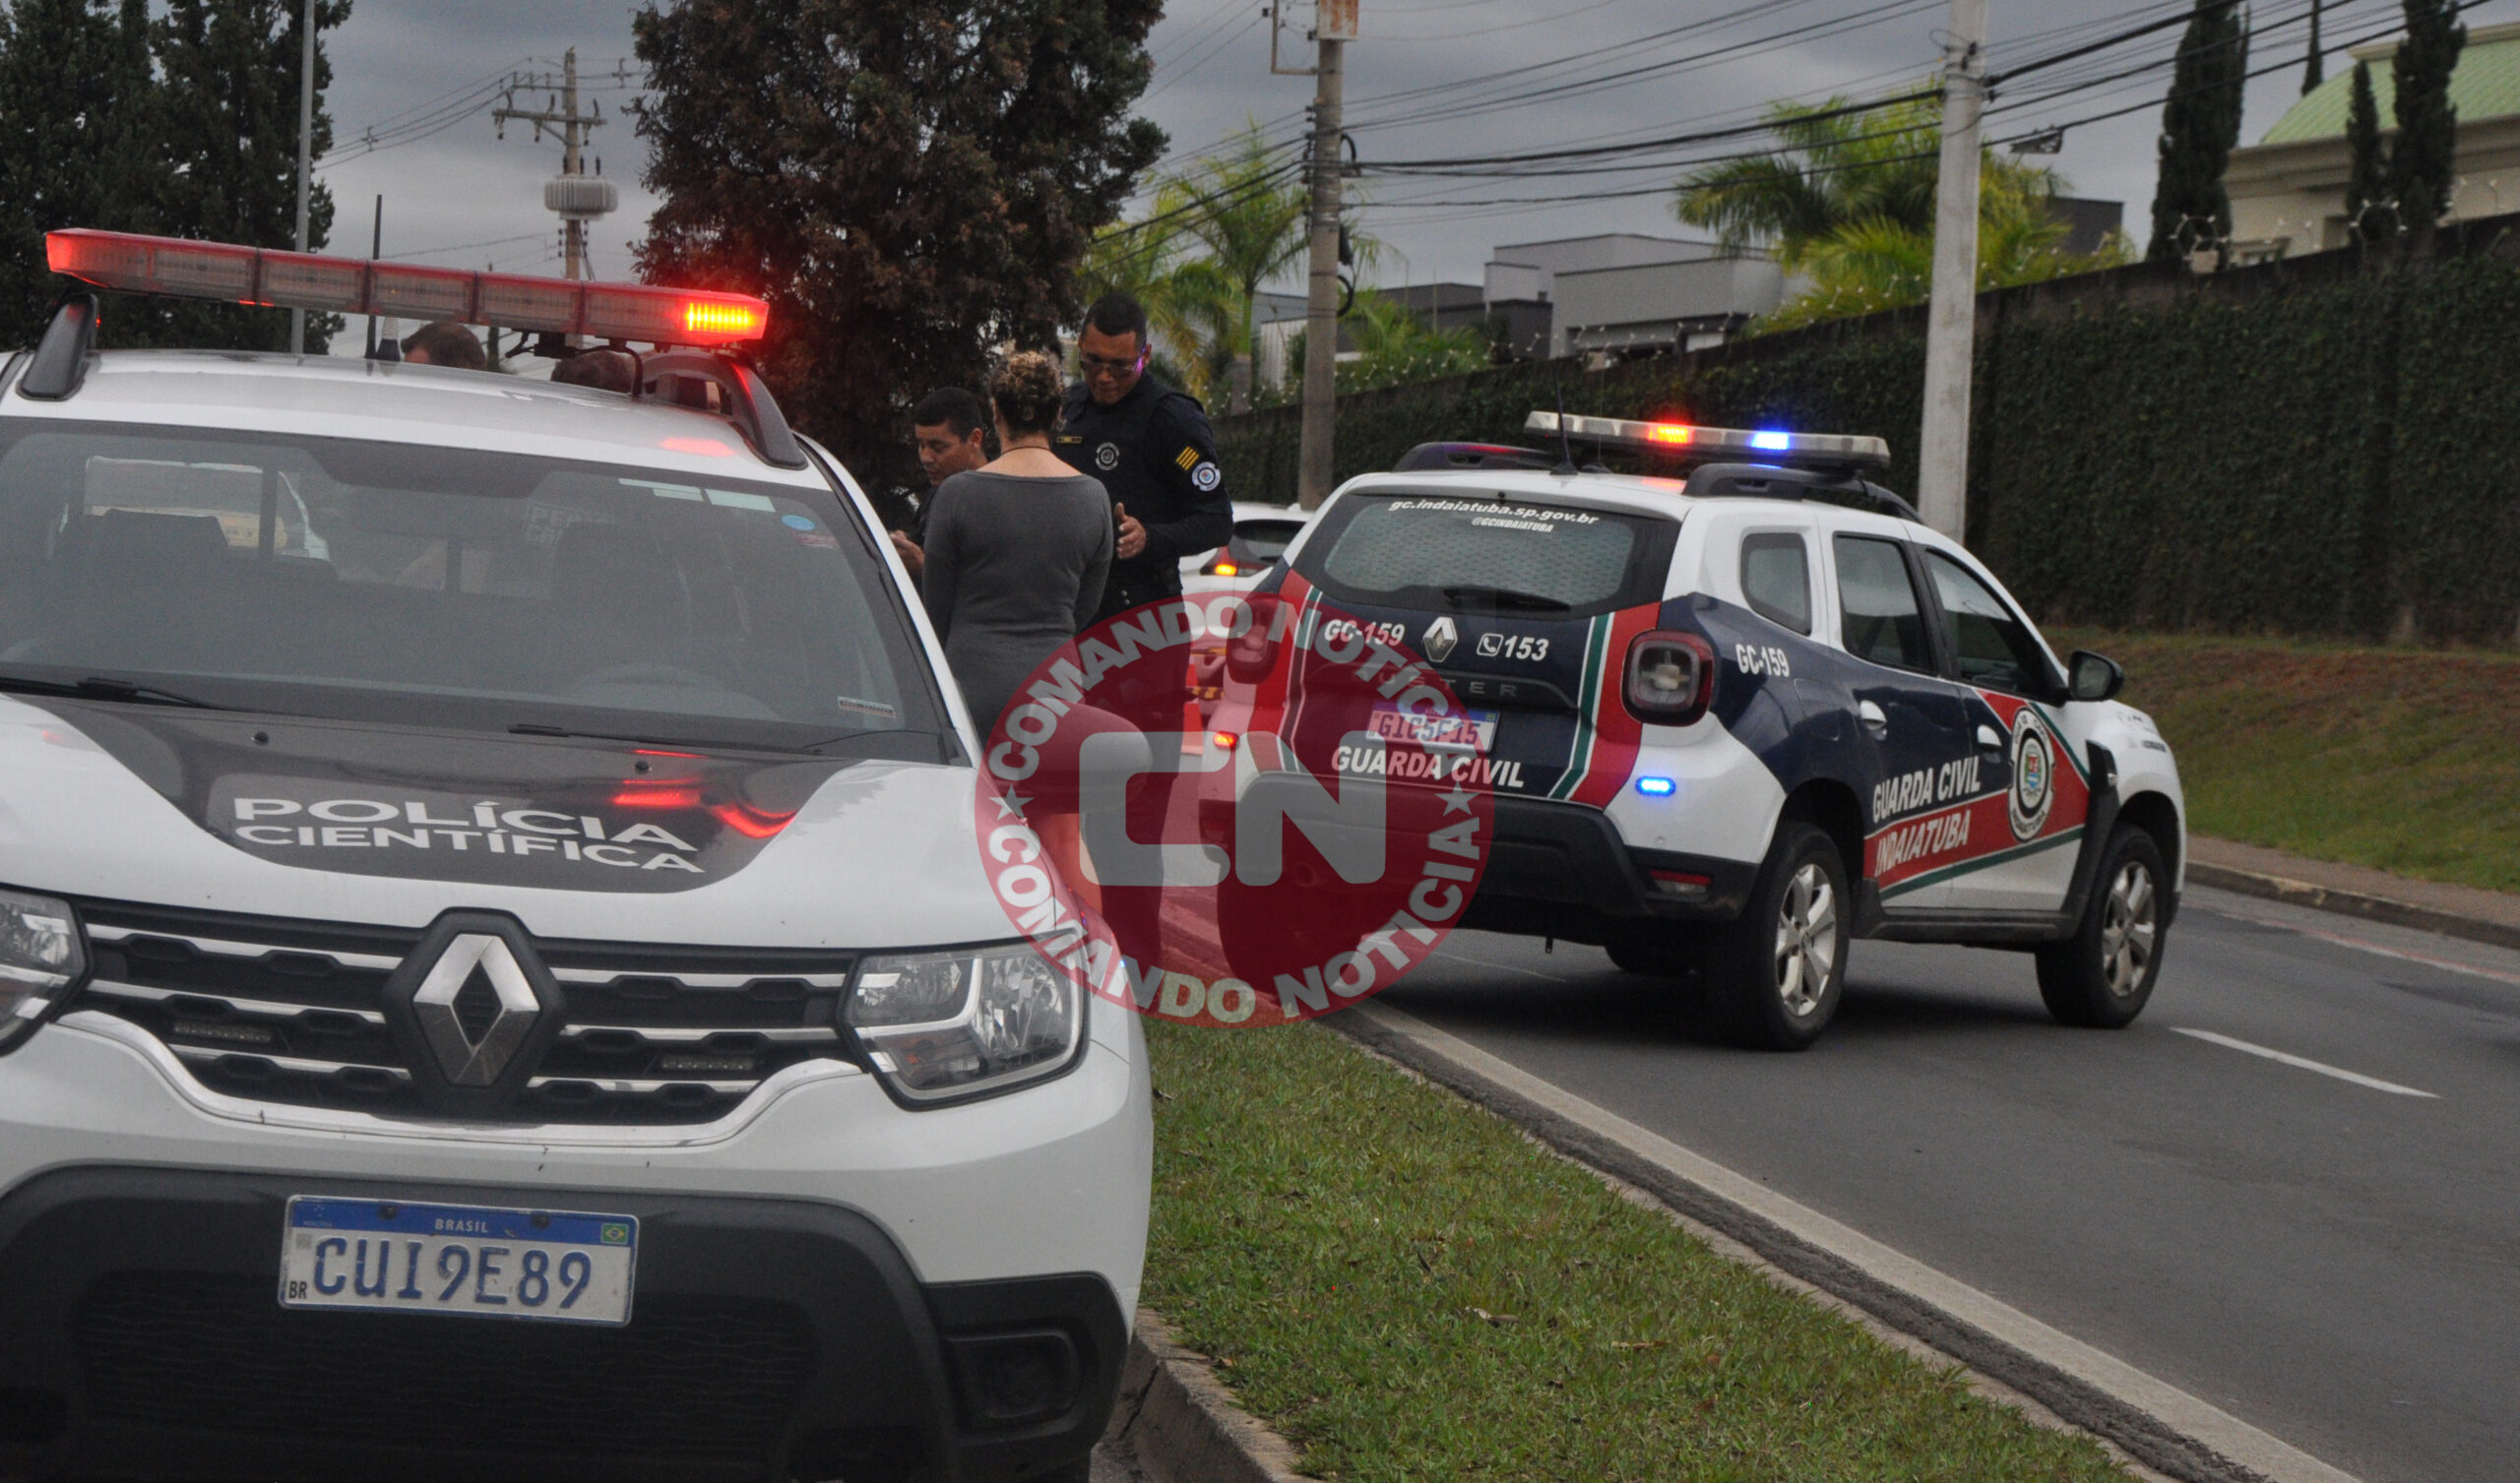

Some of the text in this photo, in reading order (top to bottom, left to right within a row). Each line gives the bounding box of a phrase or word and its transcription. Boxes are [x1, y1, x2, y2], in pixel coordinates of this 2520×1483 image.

[1389, 499, 1599, 525] gc.indaiatuba.sp.gov.br
[1472, 517, 1554, 533] @GCINDAIATUBA
[1323, 618, 1406, 648] GC-159
[1504, 635, 1549, 661] 153
[1735, 643, 1791, 678] GC-159
[1378, 712, 1481, 745] GIC5F15
[1330, 745, 1525, 788] GUARDA CIVIL
[1872, 756, 1982, 824] GUARDA CIVIL
[233, 797, 698, 852] POLÍCIA
[235, 826, 706, 873] CIENTÍFICA
[1874, 809, 1972, 877] INDAIATUBA
[434, 1218, 489, 1234] BRASIL
[288, 1280, 308, 1299] BR
[313, 1236, 593, 1310] CUI9E89
